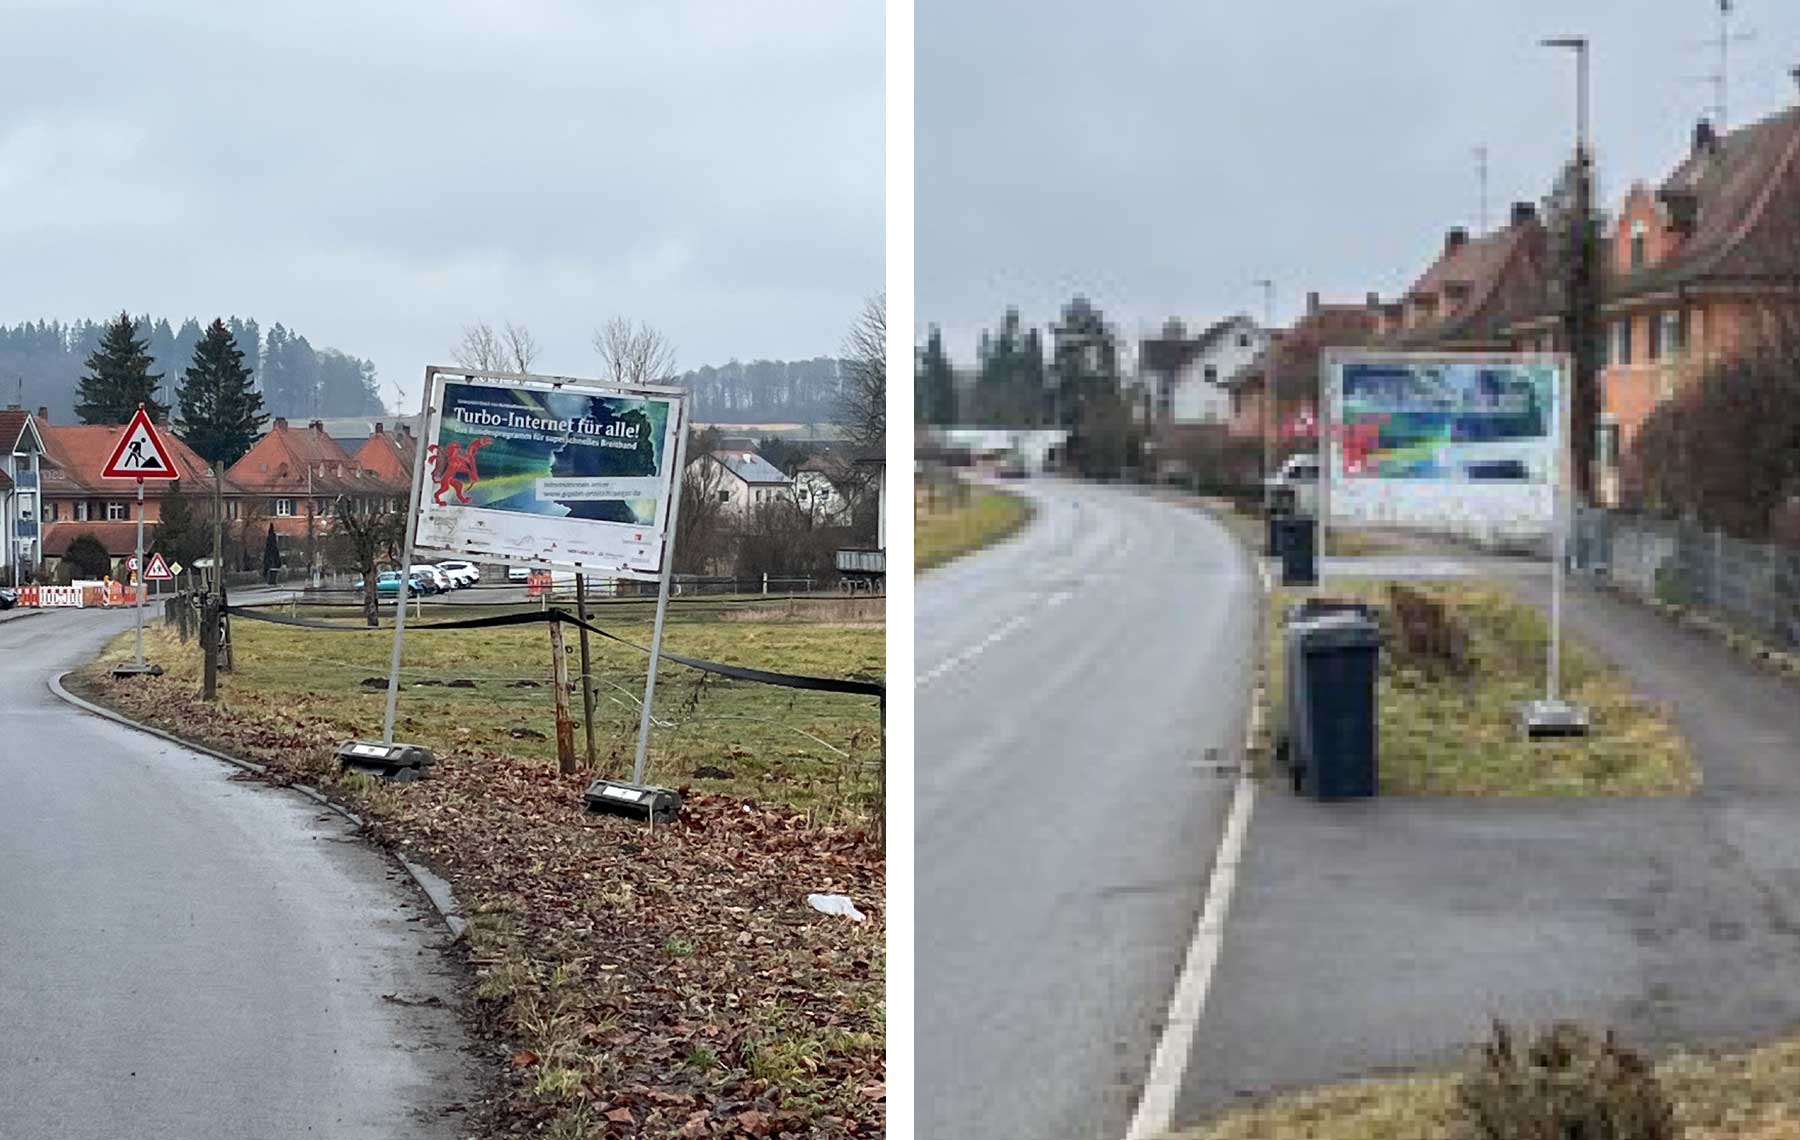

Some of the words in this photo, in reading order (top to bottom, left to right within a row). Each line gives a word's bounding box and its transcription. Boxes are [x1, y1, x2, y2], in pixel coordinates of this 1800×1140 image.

[453, 407, 575, 433] Turbo-Internet
[577, 417, 603, 435] für
[605, 421, 640, 438] alle!
